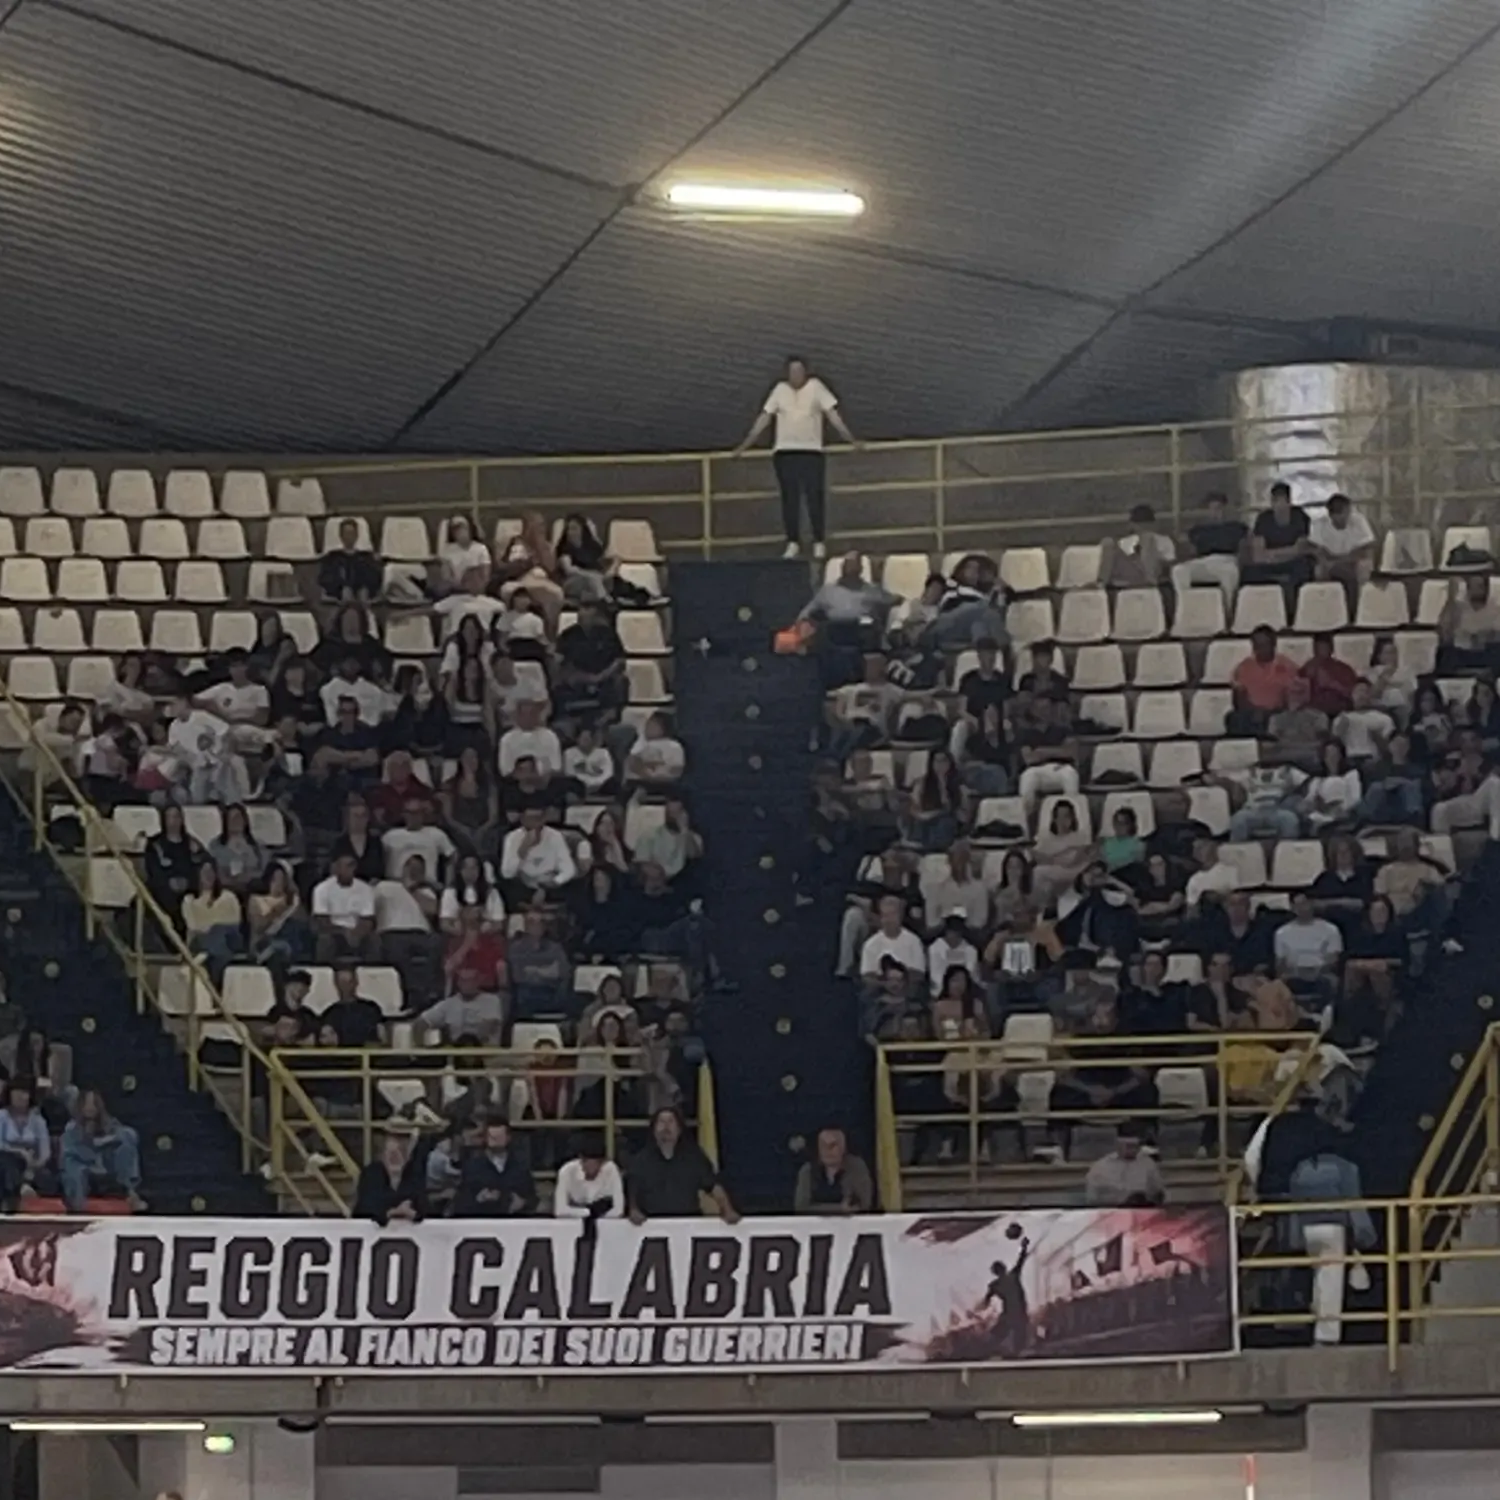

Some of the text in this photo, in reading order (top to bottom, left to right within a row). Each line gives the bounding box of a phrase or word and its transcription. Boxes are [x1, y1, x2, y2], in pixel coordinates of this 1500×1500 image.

[108, 1233, 893, 1321] REGGIO CALABRIA
[150, 1324, 864, 1368] SEMPRE AL FIANCO DEI SUOI GUERRIERI
